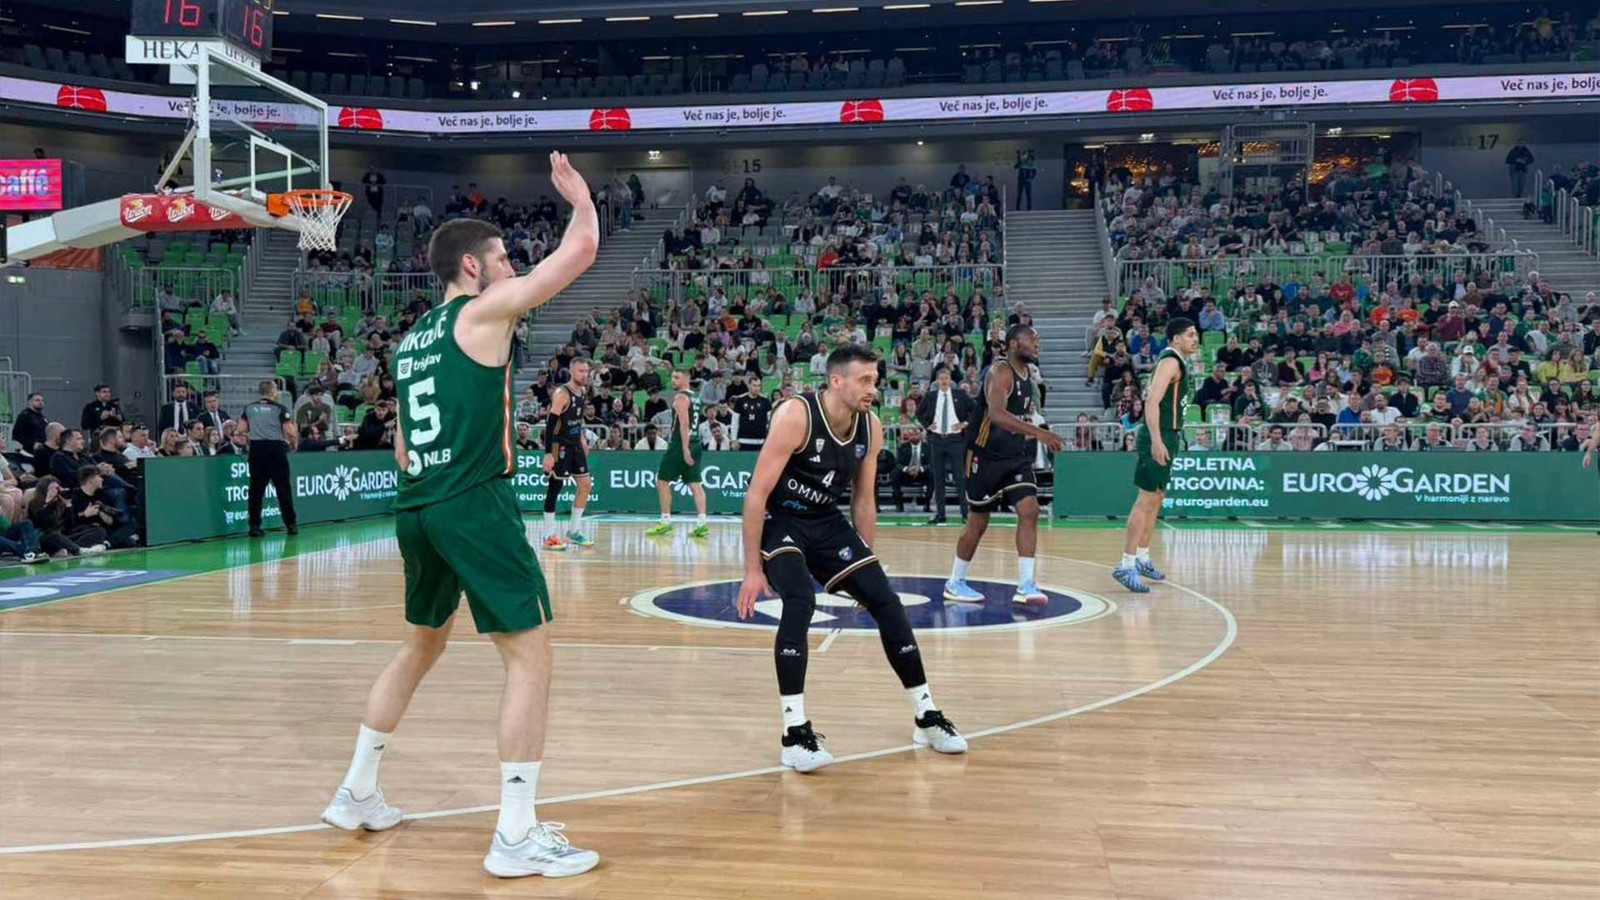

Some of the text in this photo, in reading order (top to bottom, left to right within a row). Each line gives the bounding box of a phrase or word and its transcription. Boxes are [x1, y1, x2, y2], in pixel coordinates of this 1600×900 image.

[164, 0, 201, 26] 16
[243, 5, 263, 47] 16
[1213, 85, 1328, 102] Več nas je, bolje je.
[1501, 79, 1524, 91] Več
[1527, 81, 1549, 90] nas
[1551, 78, 1567, 93] je,
[234, 104, 263, 119] bolje
[940, 97, 1048, 113] Več nas je, bolje je.
[438, 114, 538, 129] Več nas je, bolje je.
[683, 107, 786, 123] Več nas je, bolje je.
[1478, 134, 1500, 150] 17
[742, 158, 761, 173] 15
[408, 377, 441, 446] 5
[423, 448, 451, 468] NLB
[1172, 457, 1256, 471] SPLETNA
[610, 469, 660, 489] EUR
[822, 470, 836, 488] 4
[1175, 496, 1269, 509] eurogarden.eu
